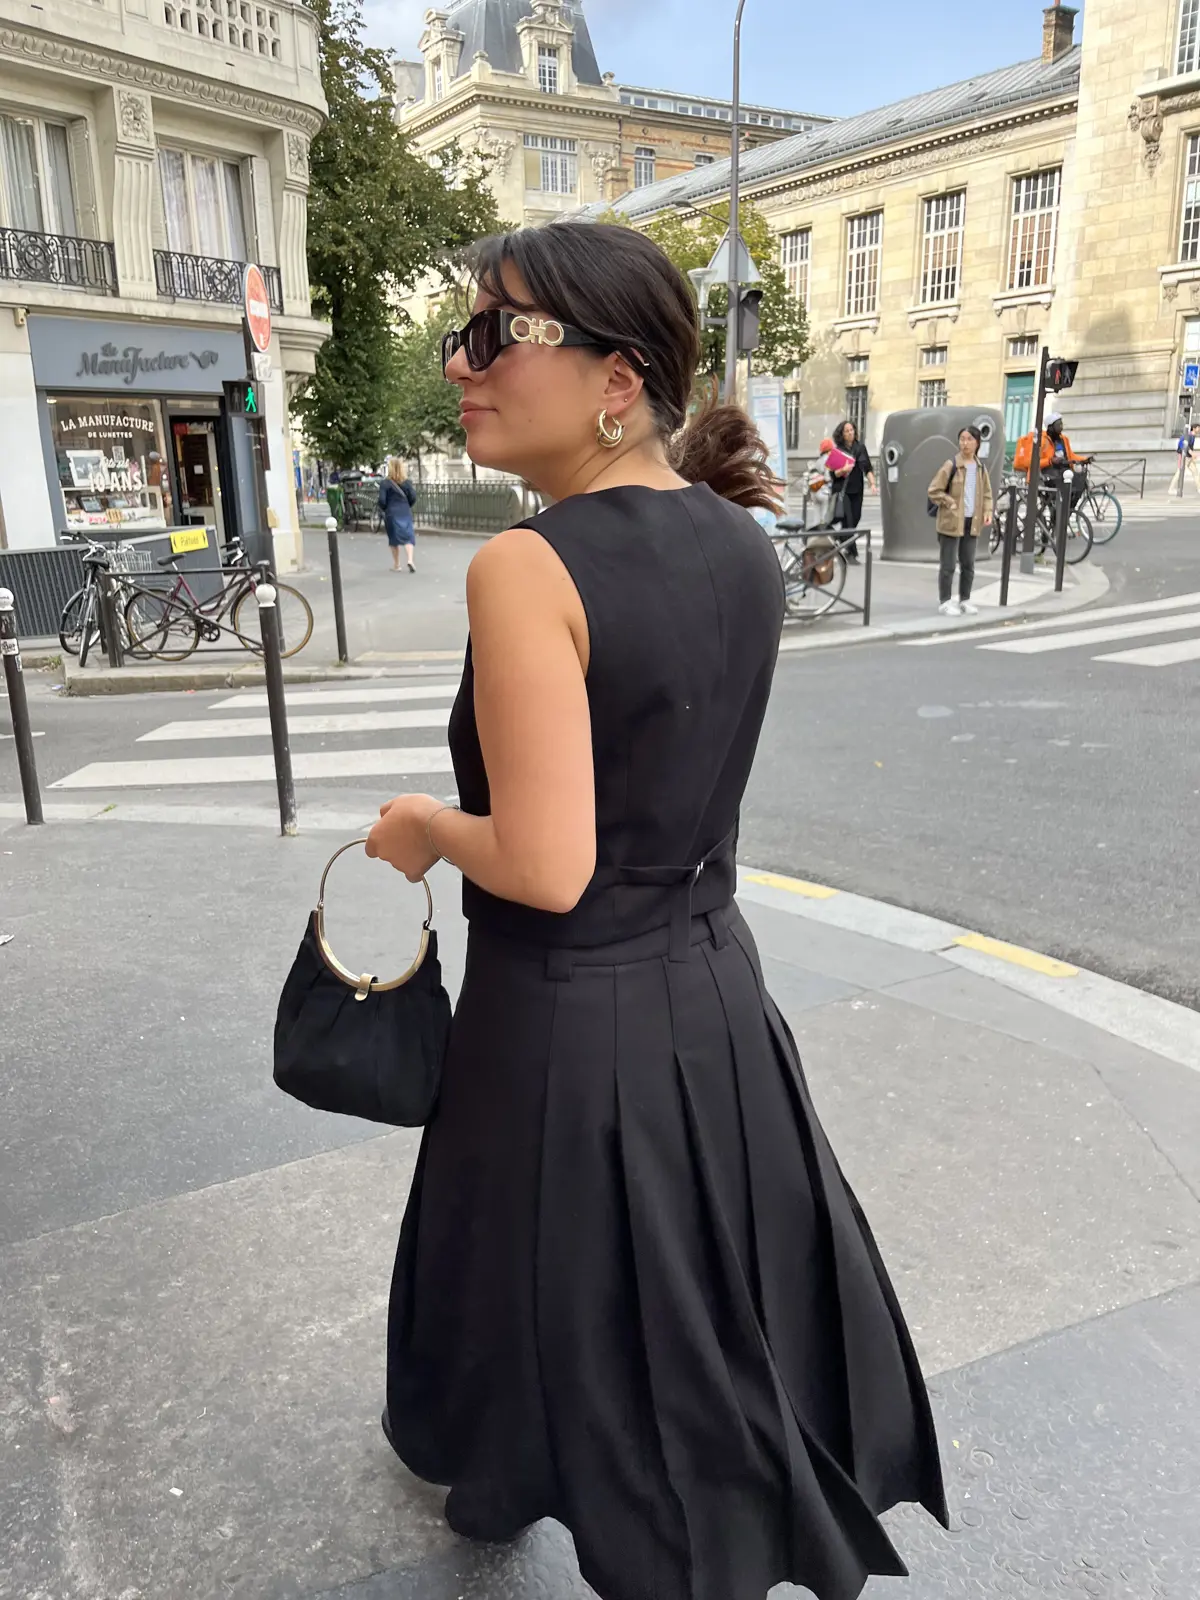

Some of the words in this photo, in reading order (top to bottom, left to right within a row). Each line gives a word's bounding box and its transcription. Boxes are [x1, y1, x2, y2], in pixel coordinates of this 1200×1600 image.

[782, 160, 901, 205] COMMERCE
[60, 418, 76, 432] LA
[77, 414, 154, 432] MANUFACTURE
[99, 431, 133, 439] LUNETTES
[88, 471, 105, 493] 10
